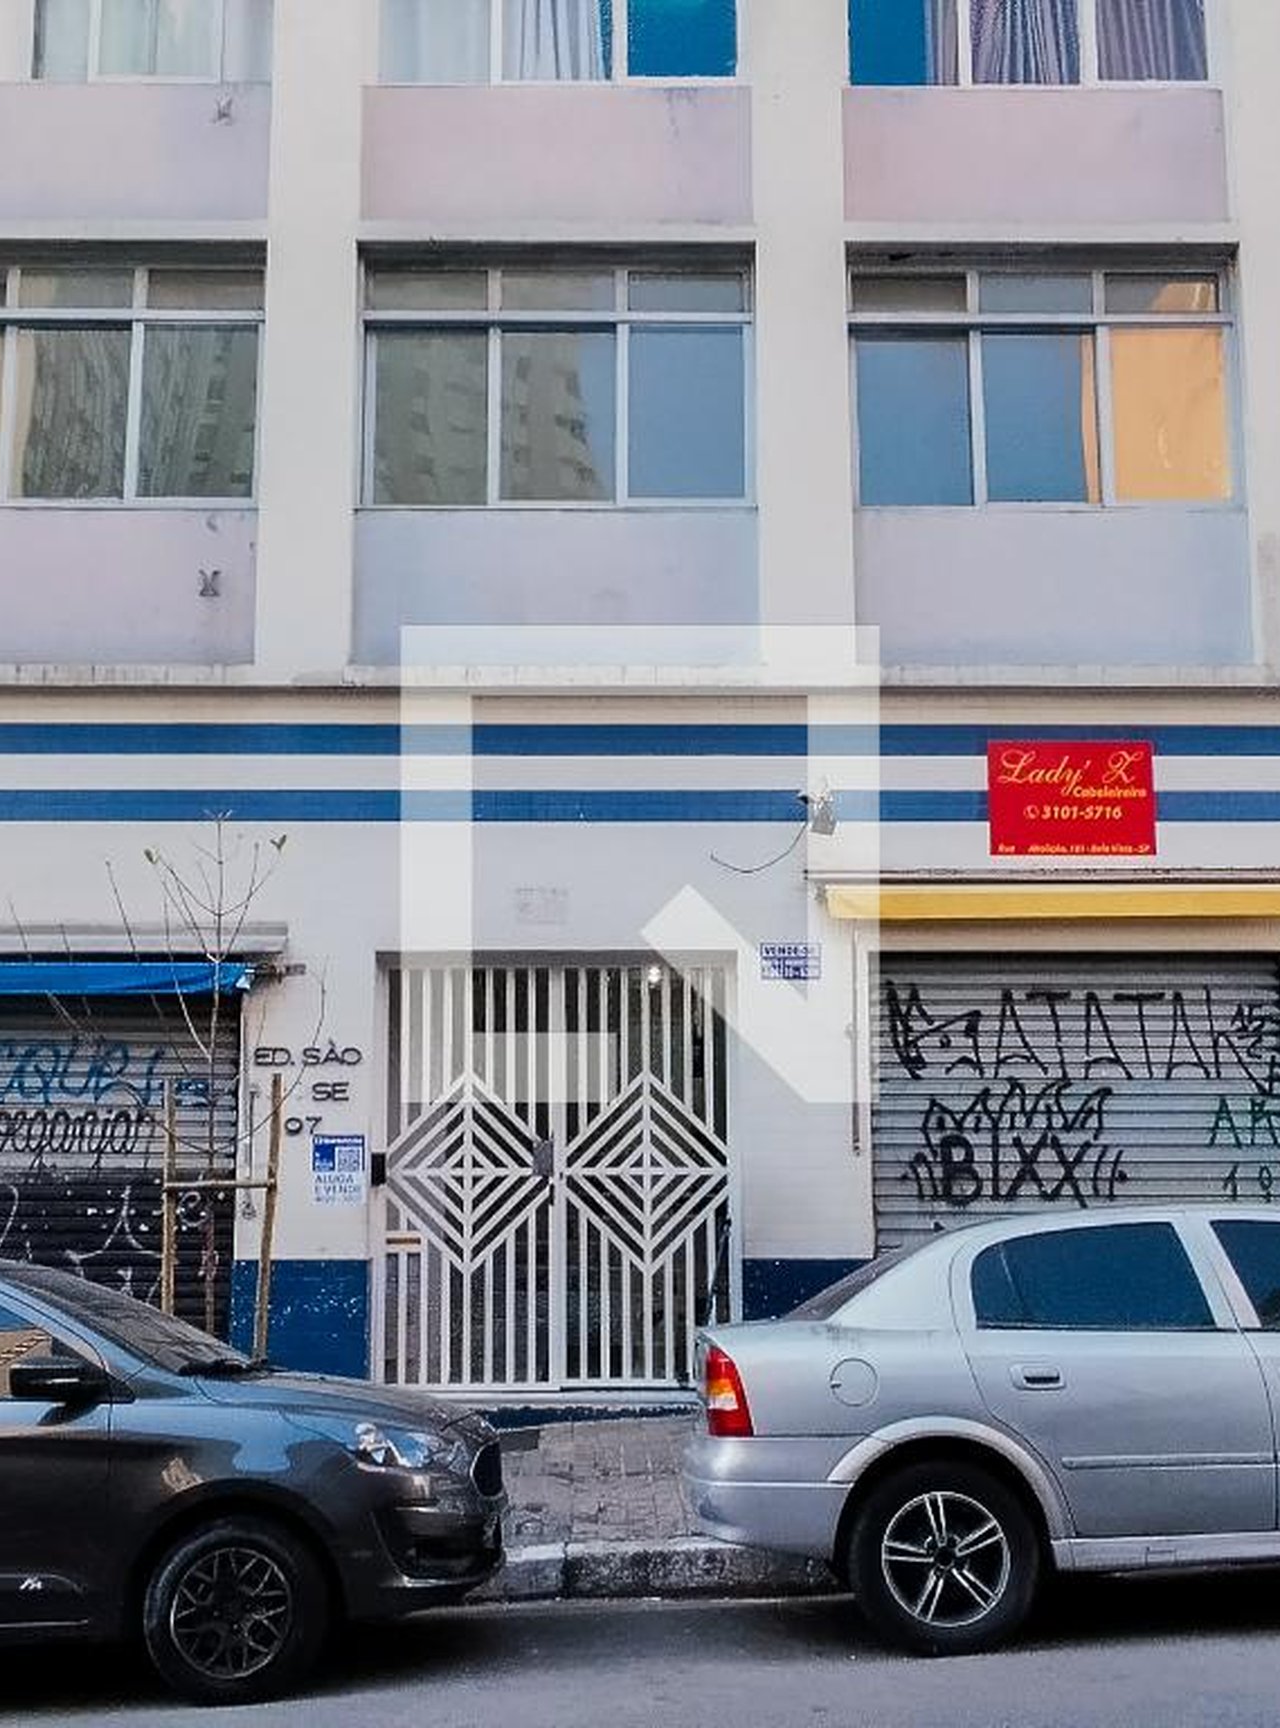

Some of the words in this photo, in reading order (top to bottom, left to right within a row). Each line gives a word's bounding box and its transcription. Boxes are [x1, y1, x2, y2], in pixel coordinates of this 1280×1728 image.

[1041, 805, 1123, 820] 3101-5716
[254, 1047, 295, 1066] ED.
[312, 1081, 350, 1102] SE
